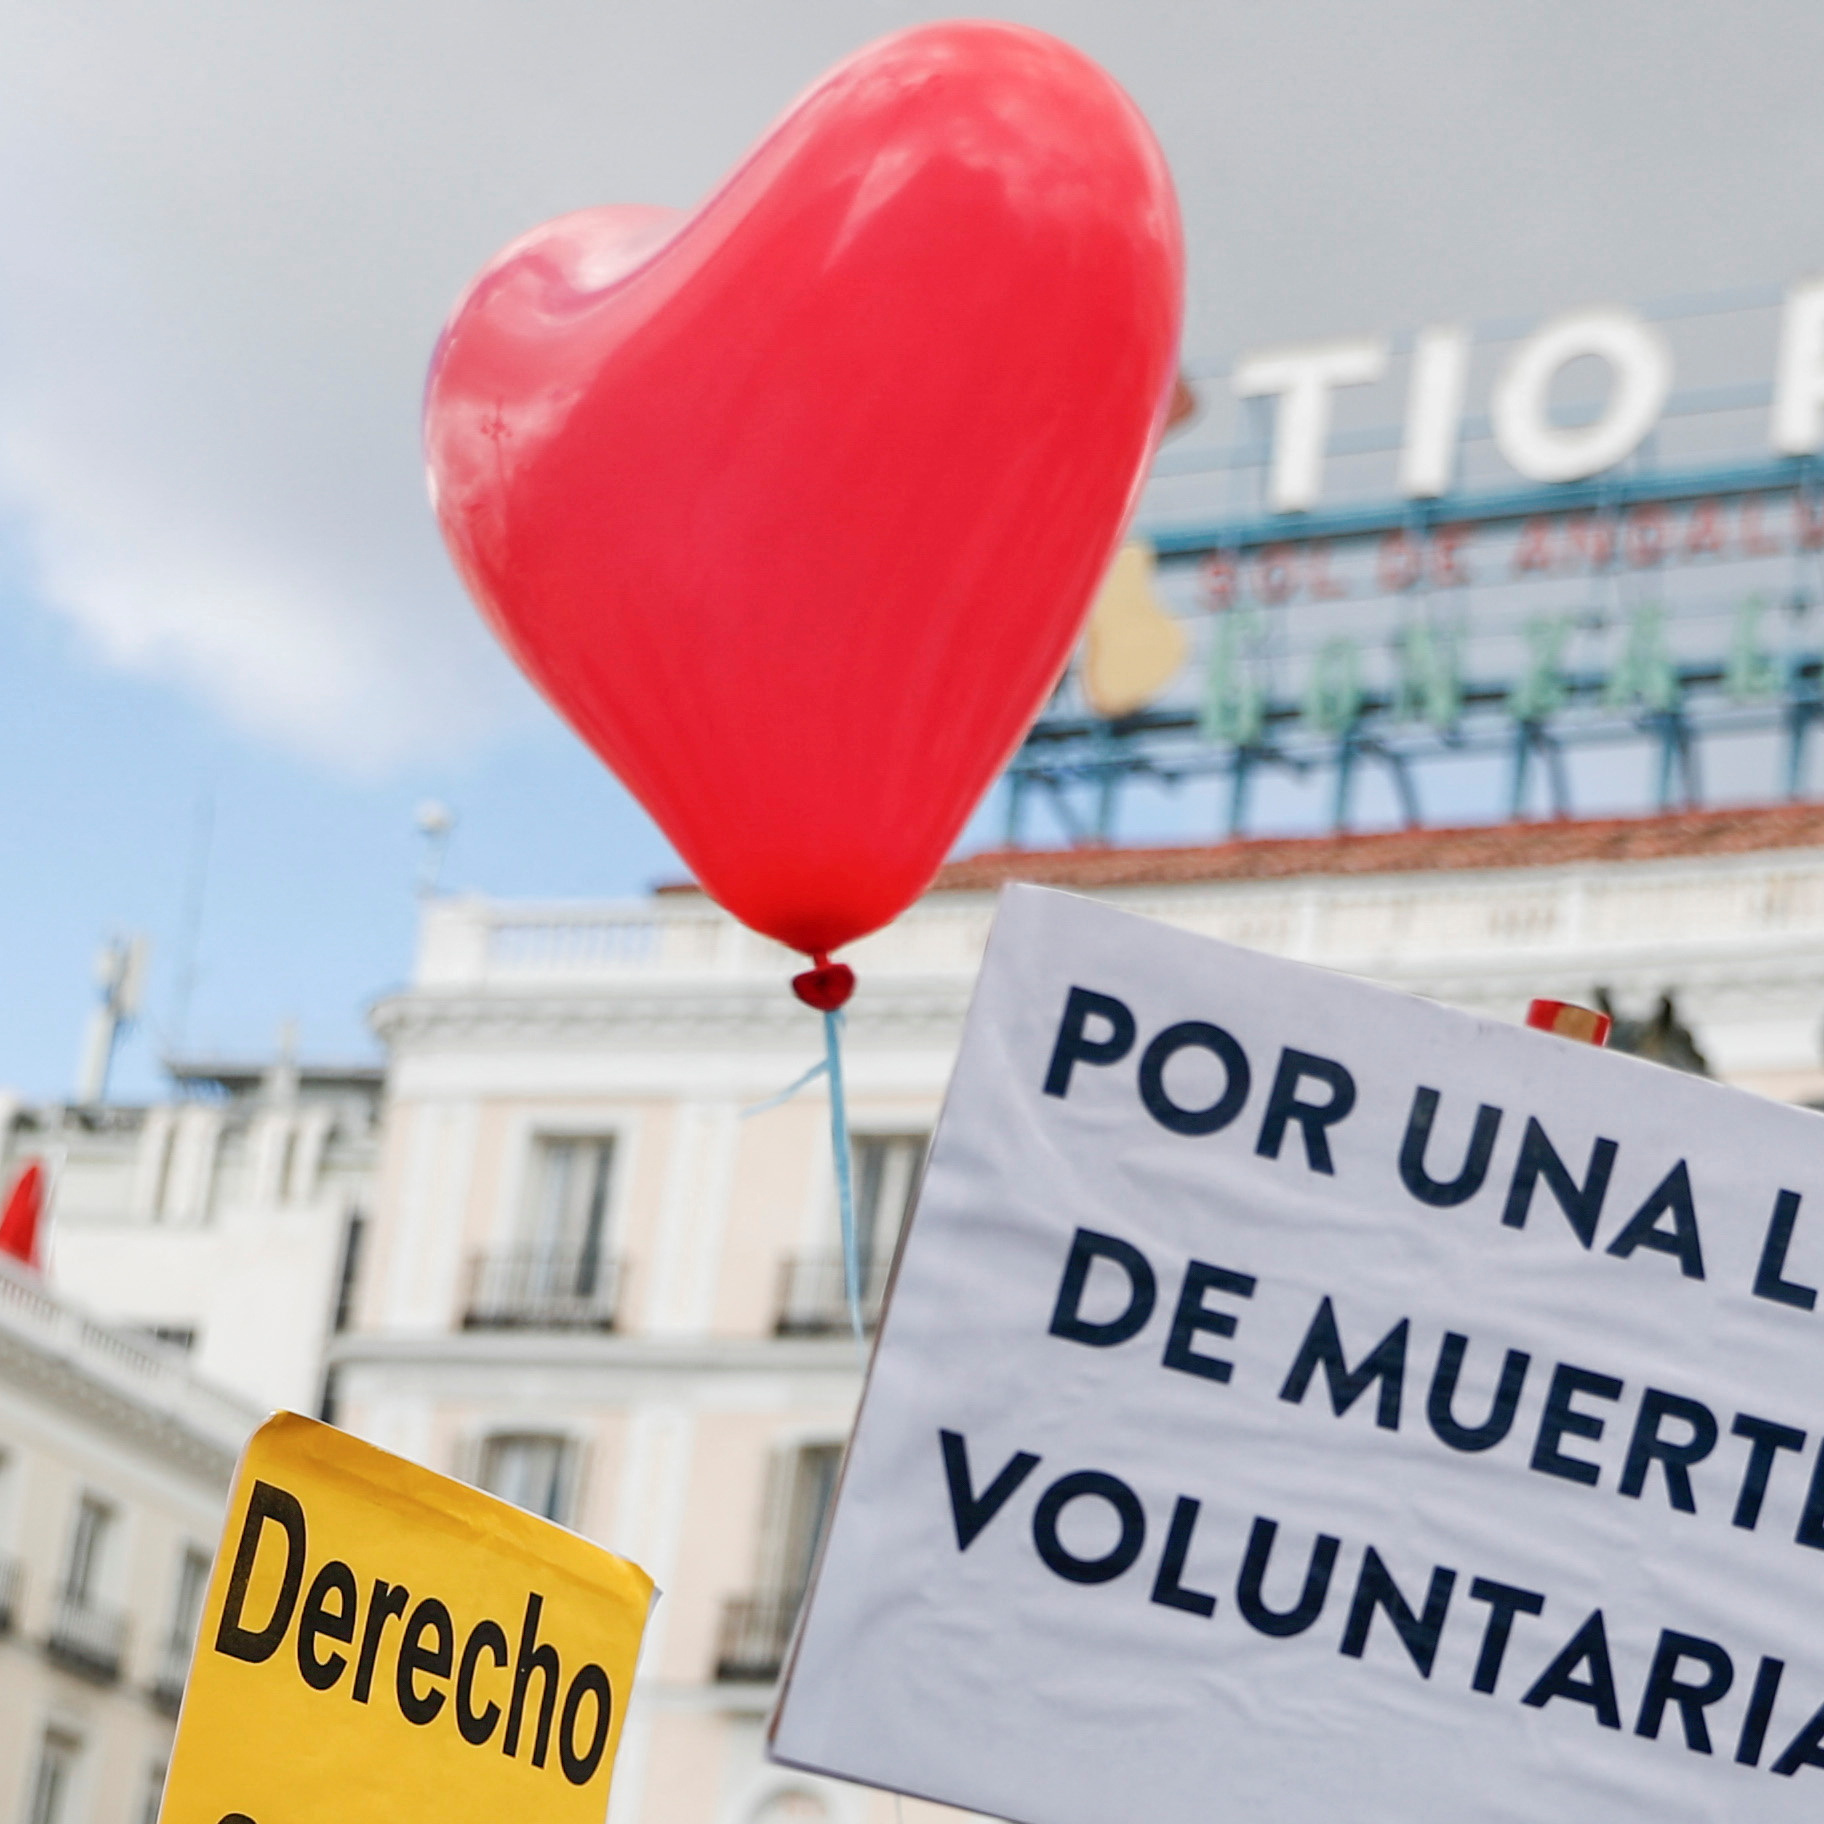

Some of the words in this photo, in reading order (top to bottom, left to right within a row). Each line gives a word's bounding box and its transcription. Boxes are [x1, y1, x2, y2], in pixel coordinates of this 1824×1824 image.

[1230, 306, 1675, 513] TIO
[1042, 985, 1358, 1177] POR
[1398, 1085, 1706, 1281] UNA
[1046, 1227, 1259, 1386] DE
[214, 1479, 613, 1787] Derecho
